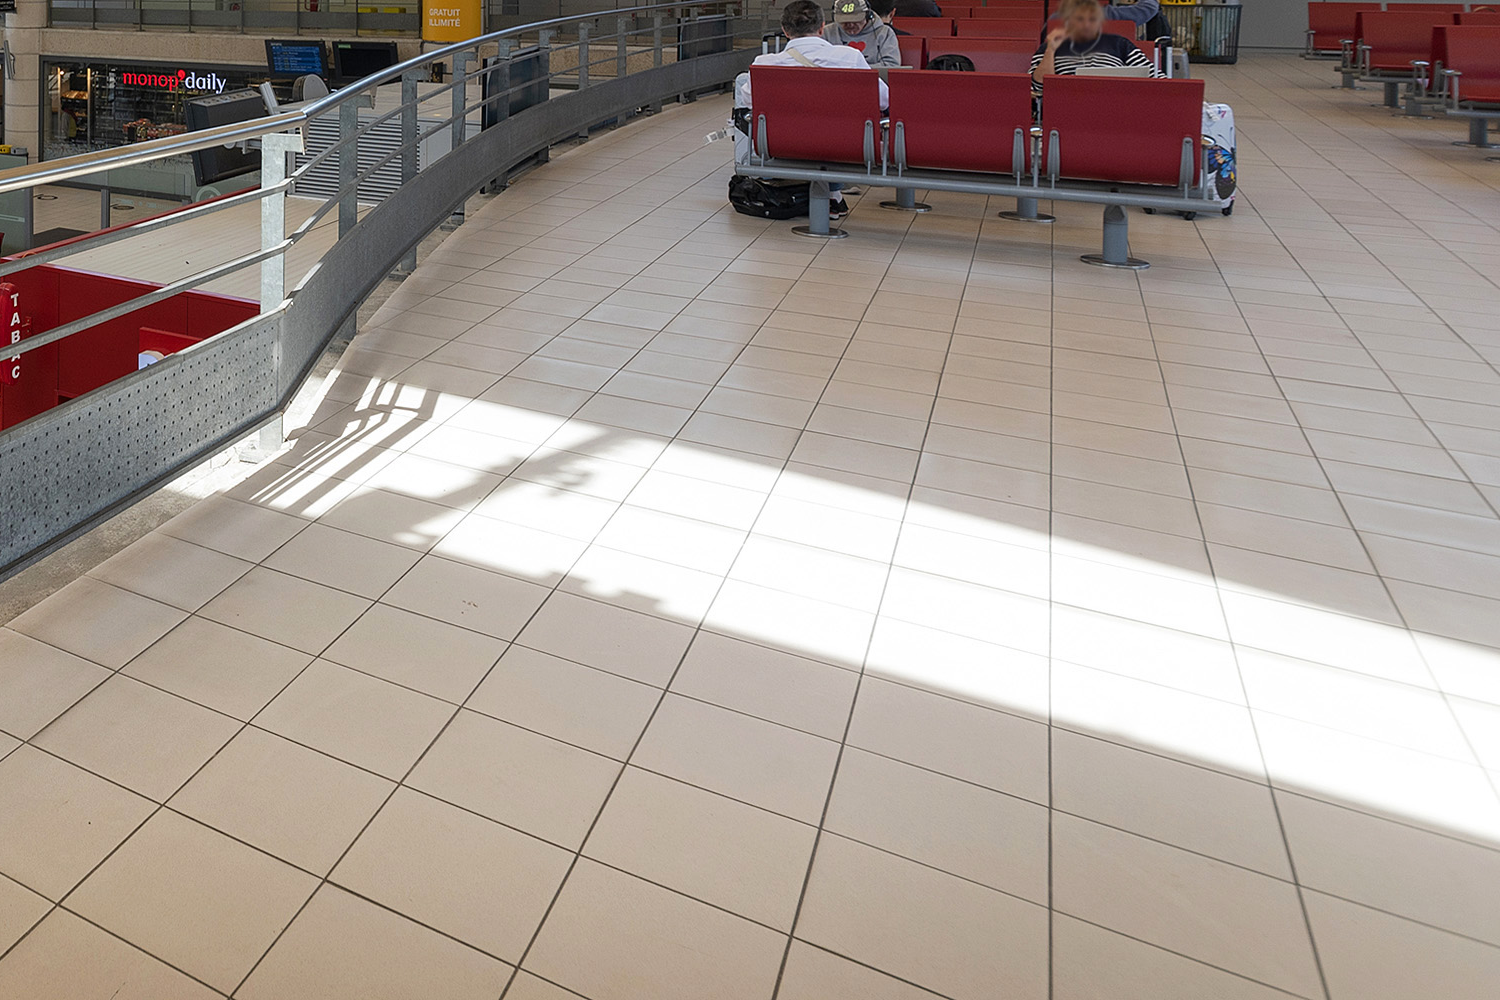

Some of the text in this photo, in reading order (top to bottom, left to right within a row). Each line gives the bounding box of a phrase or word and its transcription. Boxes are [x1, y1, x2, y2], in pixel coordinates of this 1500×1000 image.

[429, 8, 460, 17] GRATUIT
[841, 3, 855, 13] 48
[429, 18, 460, 27] ILLIMITÉ
[123, 69, 226, 94] monop'daily
[10, 292, 21, 379] TABAC
